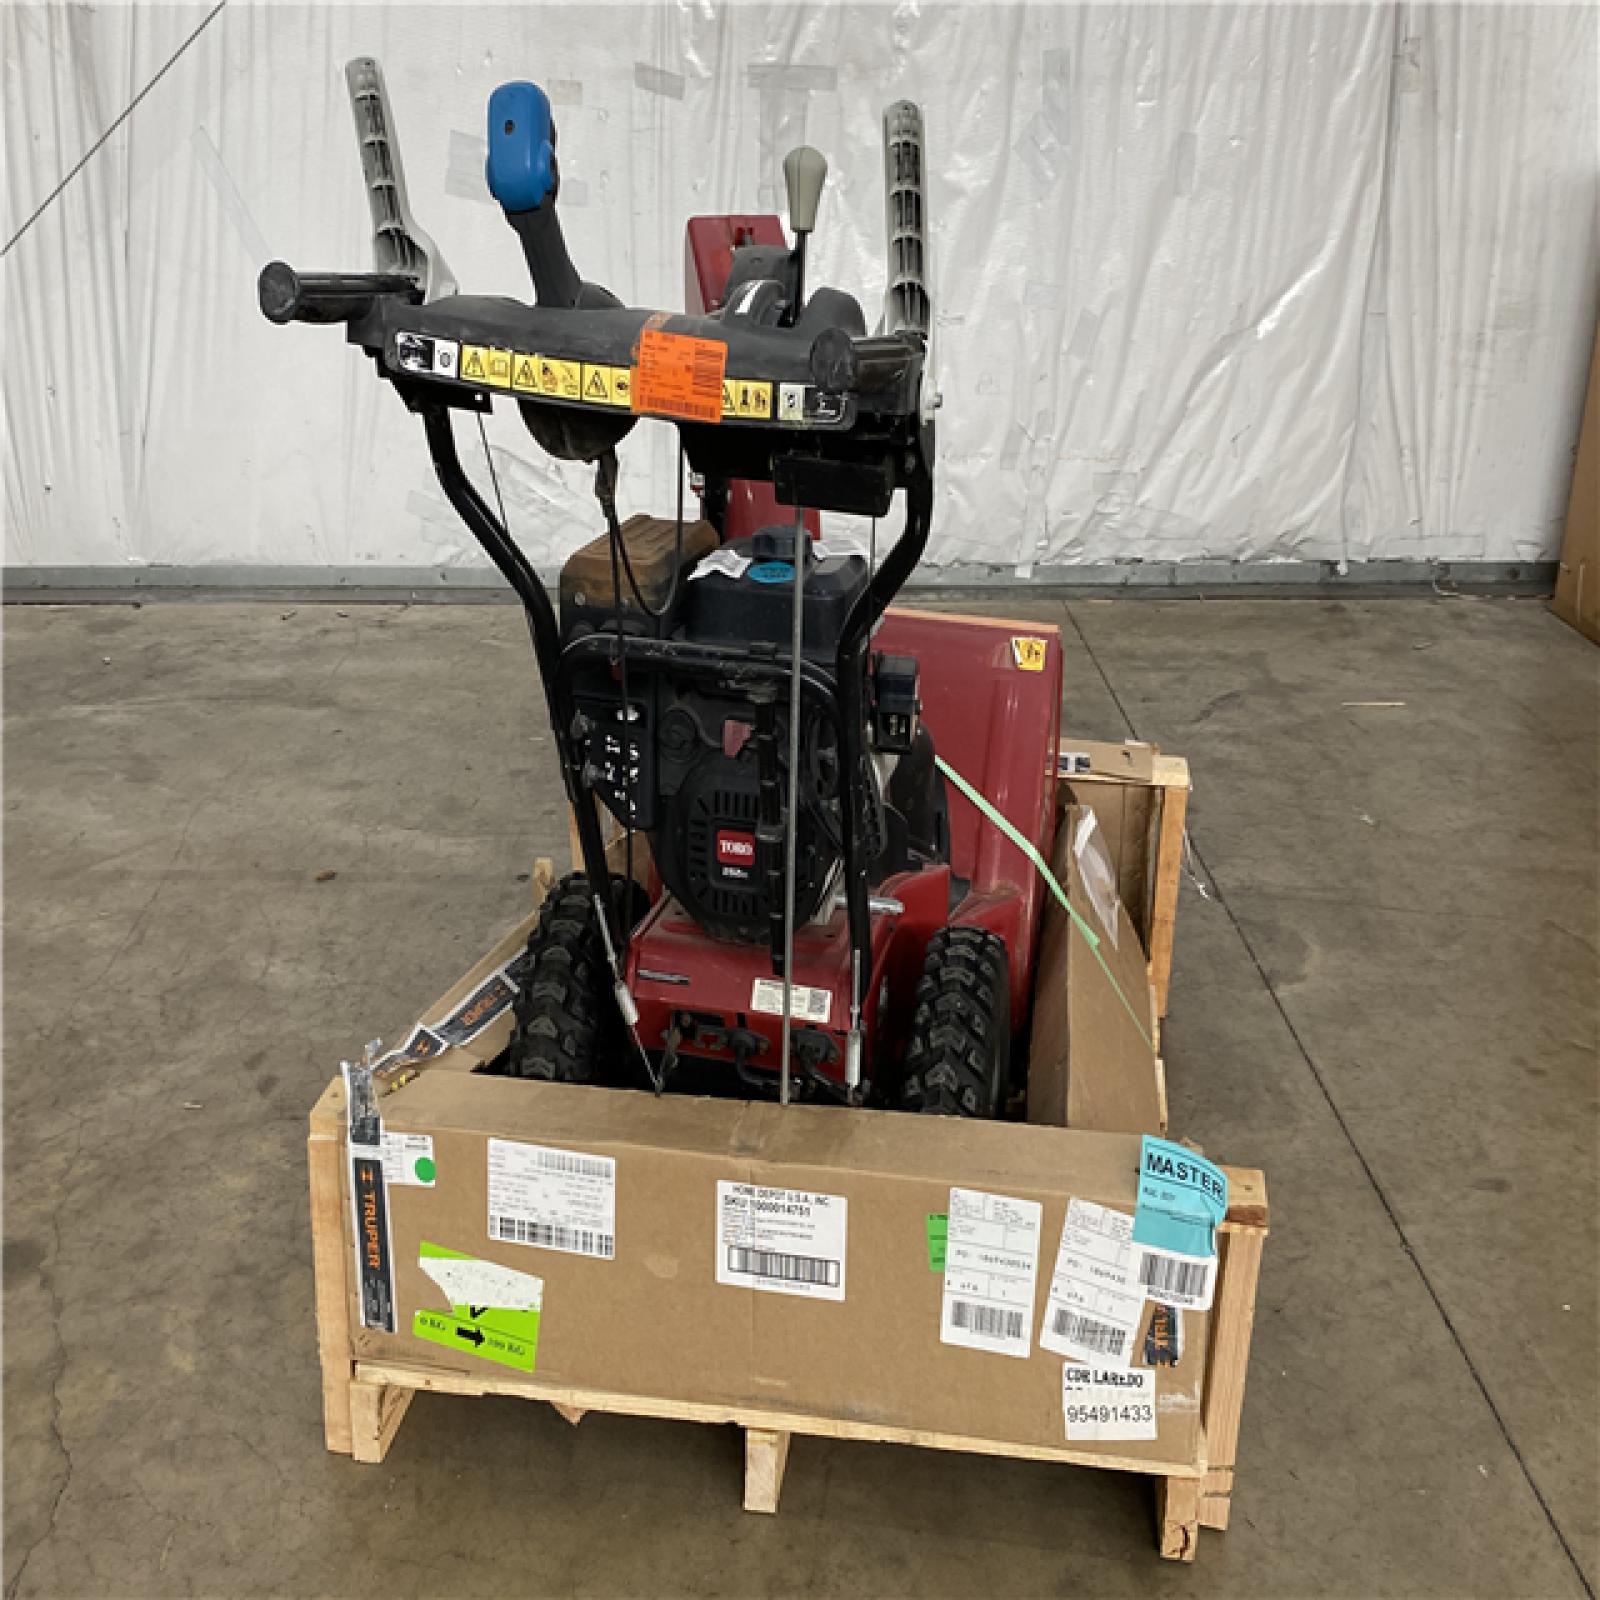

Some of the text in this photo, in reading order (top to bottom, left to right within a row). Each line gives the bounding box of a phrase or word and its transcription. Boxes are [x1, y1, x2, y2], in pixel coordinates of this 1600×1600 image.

[720, 839, 753, 856] TORO
[1147, 1151, 1224, 1197] MASTER
[1066, 1368, 1091, 1384] CDR
